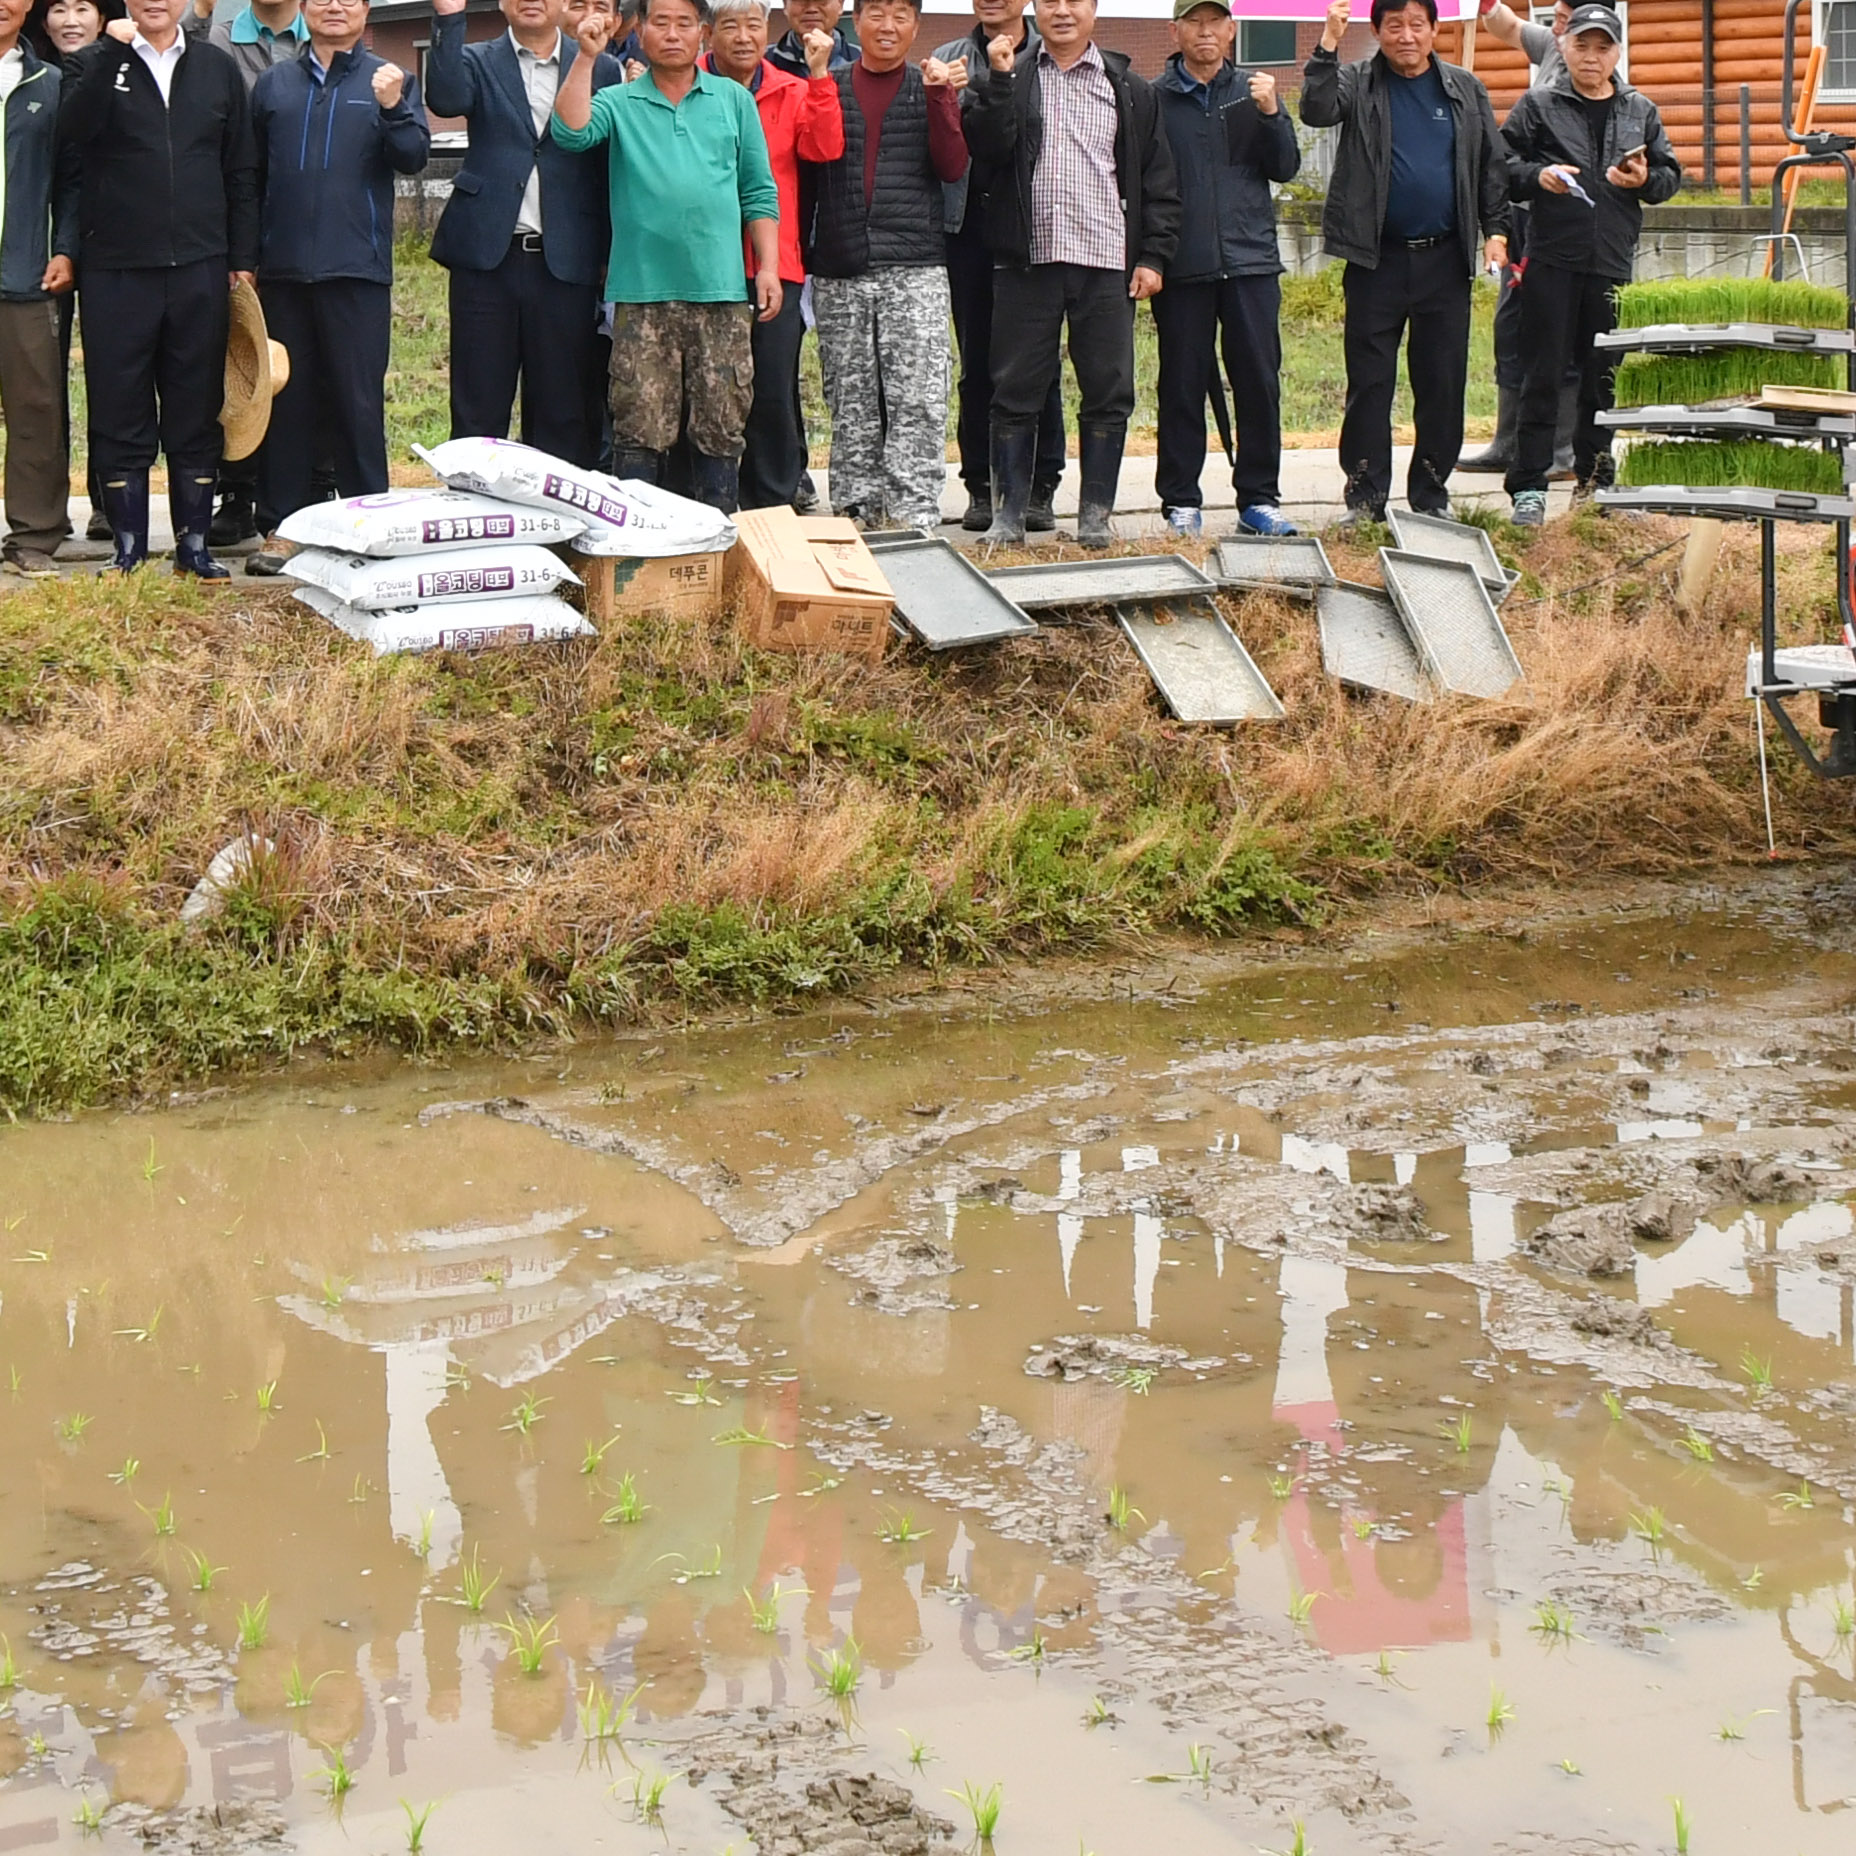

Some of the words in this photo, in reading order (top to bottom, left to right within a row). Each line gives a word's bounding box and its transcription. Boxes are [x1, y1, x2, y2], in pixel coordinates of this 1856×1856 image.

[520, 518, 561, 532] 31-6-8
[434, 569, 483, 594] 올코팅
[520, 568, 561, 583] 31-6-
[669, 563, 709, 583] 데푸콘
